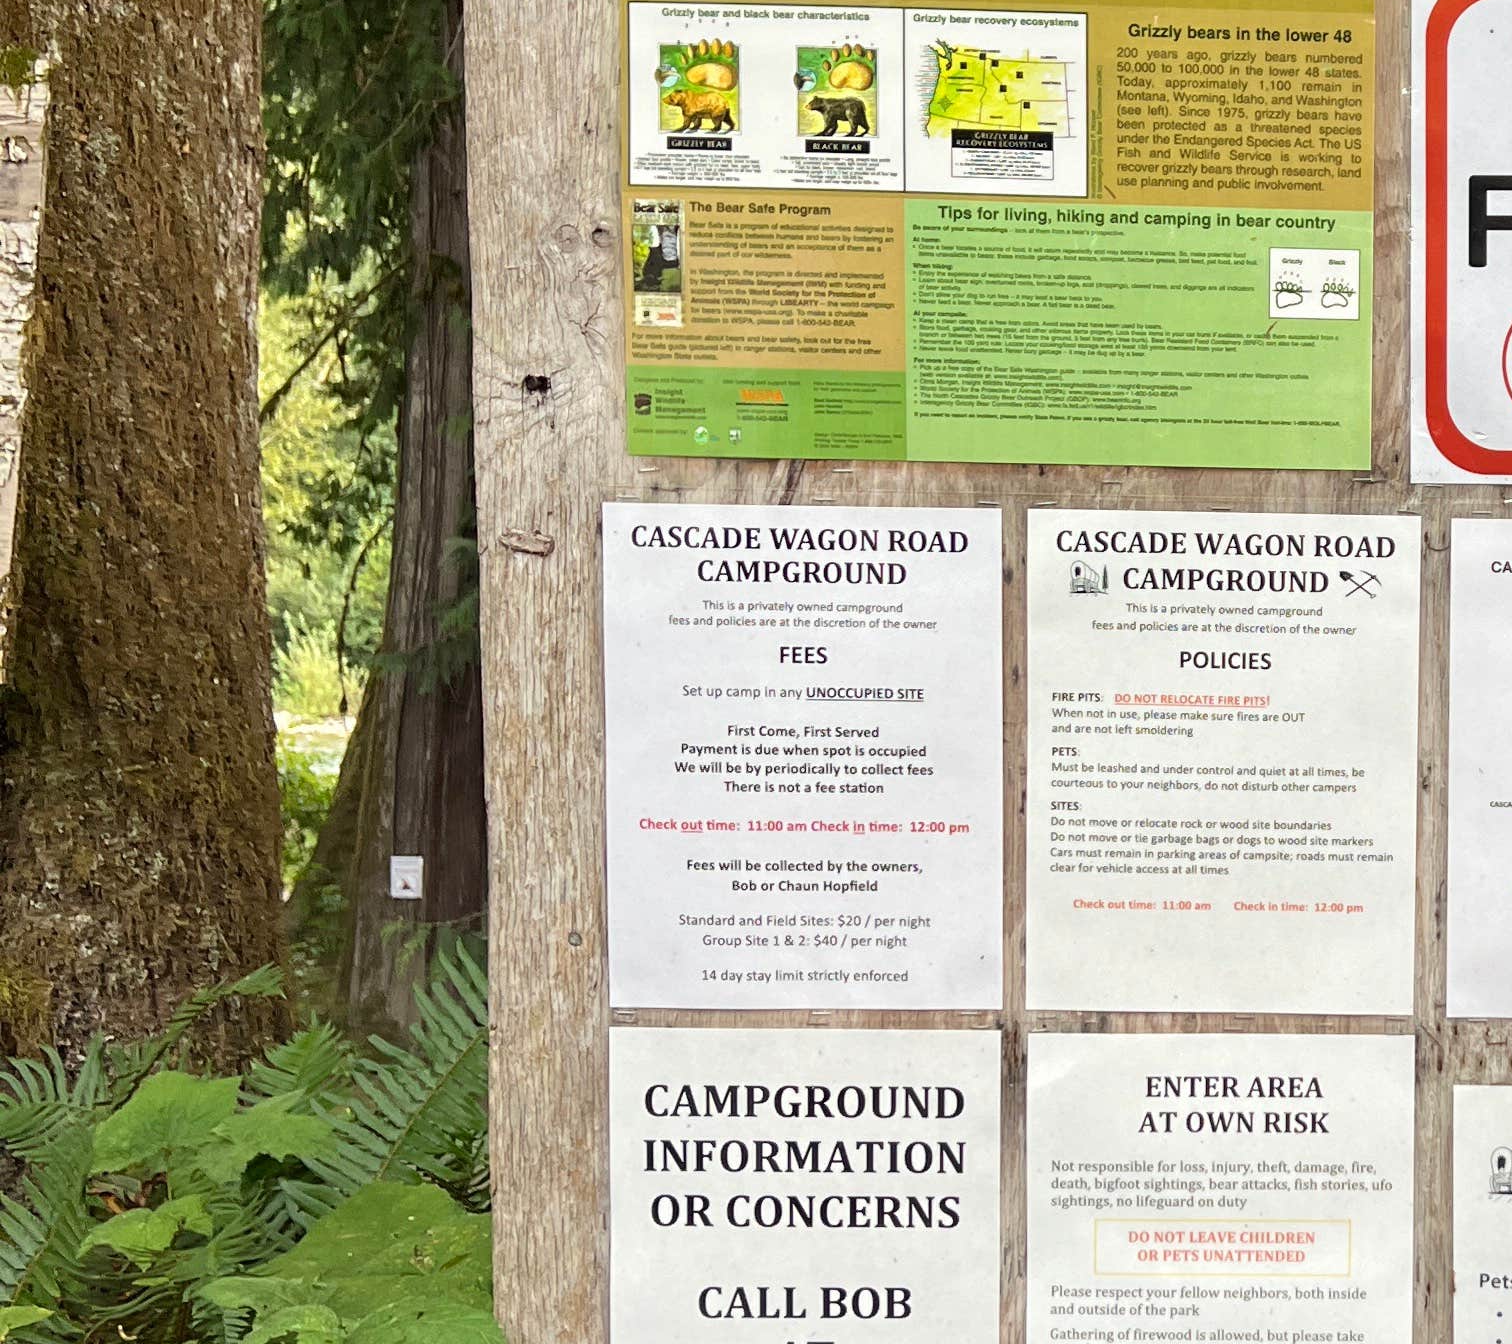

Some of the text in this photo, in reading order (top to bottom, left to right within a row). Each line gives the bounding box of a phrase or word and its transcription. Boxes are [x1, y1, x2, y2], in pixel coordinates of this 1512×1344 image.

[661, 7, 870, 21] Grizzly bear and black bear characteristics
[913, 13, 1079, 28] Grizzly bear recovery ecosystems
[1128, 23, 1352, 43] Grizzly bears in the lower 48
[689, 201, 831, 217] The Bear Safe Program
[938, 205, 1335, 232] Tips for living, hiking and camping in bear country
[631, 525, 968, 553] CASCADE WAGON ROAD
[1056, 530, 1395, 558] CASCADE WAGON ROAD
[697, 559, 906, 584] CAMPGROUND
[1123, 567, 1328, 592] CAMPGROUND
[779, 646, 827, 664] FEES
[1180, 651, 1271, 670] POLICIES
[682, 684, 924, 699] Set up camp in any UNOCCUPIED SITE
[1052, 692, 1104, 703] FIRE PITS:
[1114, 693, 1270, 706] DO NOT RELOCATE FIRE PITS!
[1146, 1076, 1323, 1098] ENTER AREA
[644, 1084, 964, 1119] CAMPGROUND
[1138, 1111, 1328, 1133] AT OWN RISK
[643, 1139, 966, 1173] INFORMATION
[651, 1194, 959, 1228] OR CONCERNS
[1128, 1231, 1314, 1244] DO NOT LEAVE CHILDREN
[1137, 1249, 1305, 1262] OR PETS UNATTENDED
[698, 1286, 911, 1319] CALL BOB
